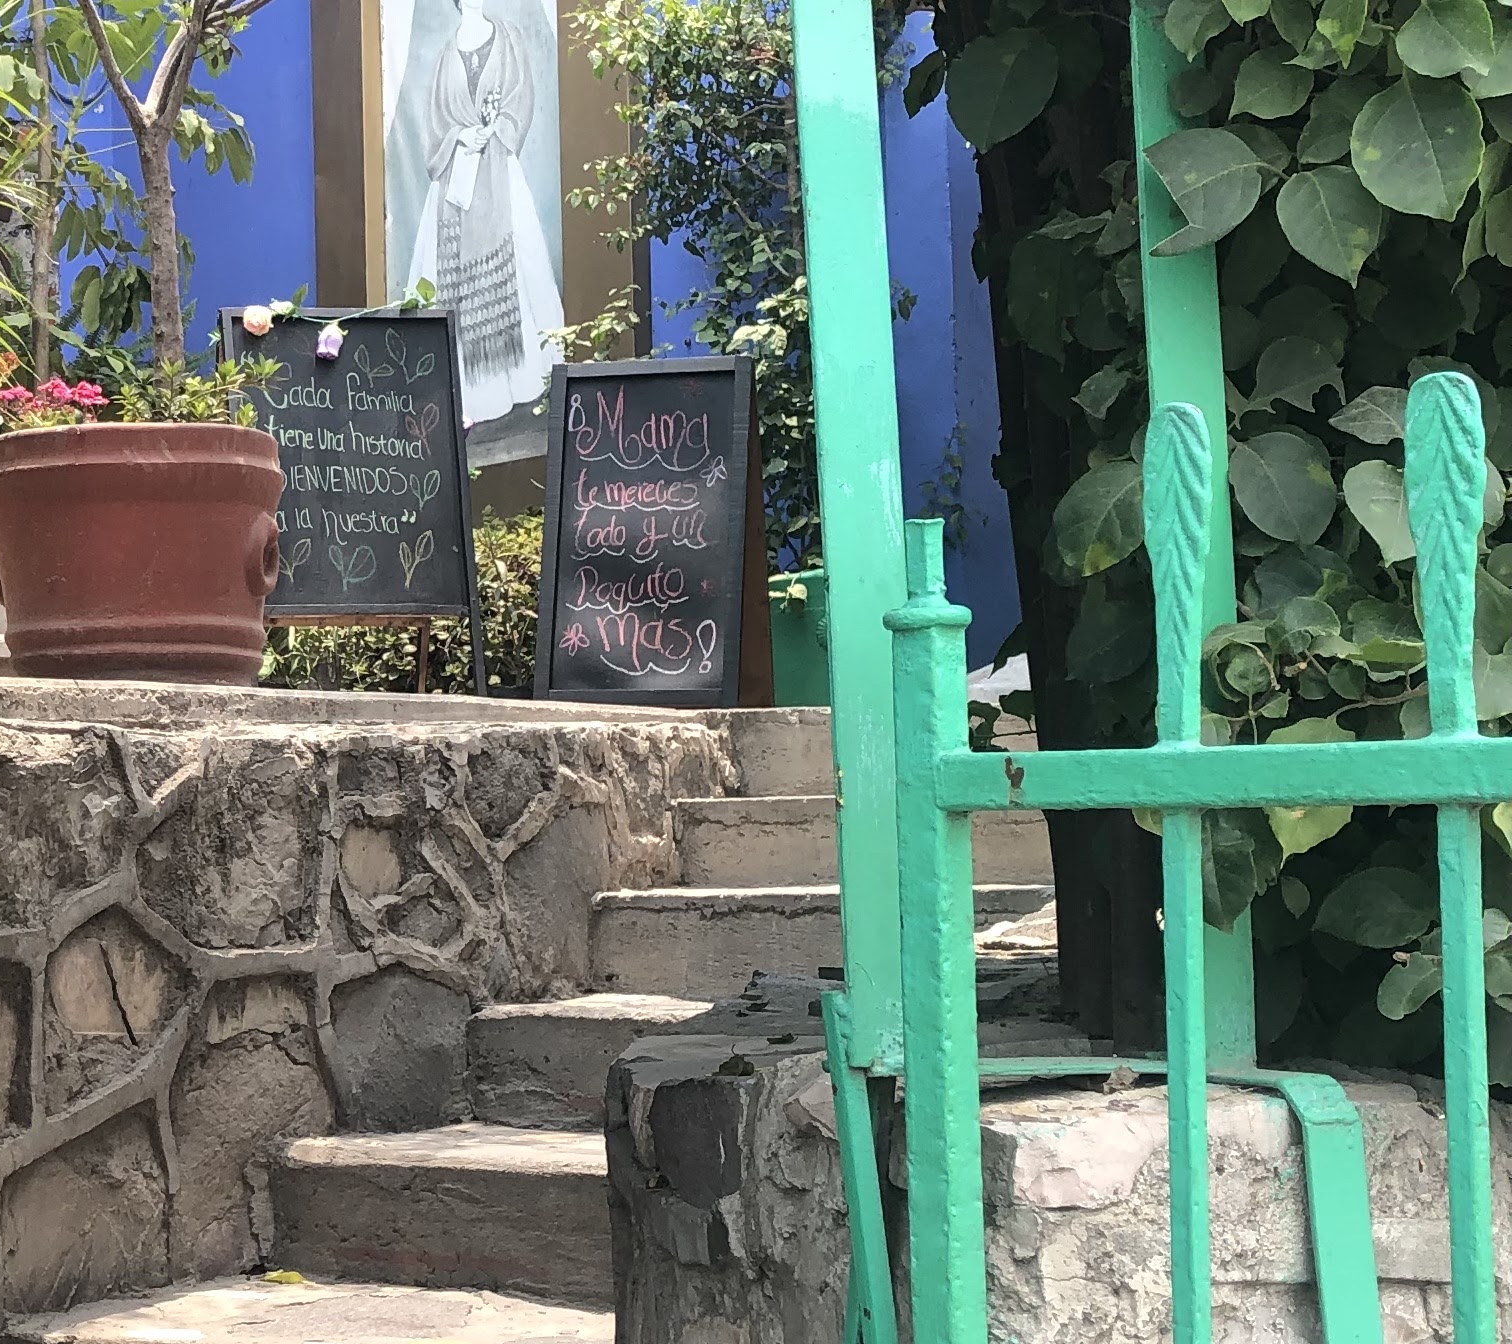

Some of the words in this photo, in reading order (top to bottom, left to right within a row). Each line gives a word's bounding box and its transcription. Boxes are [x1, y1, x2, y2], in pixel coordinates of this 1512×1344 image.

[346, 372, 417, 415] familia
[263, 414, 314, 450] tiene
[349, 420, 425, 460] historia
[573, 467, 599, 506] te
[295, 508, 314, 530] la
[635, 515, 668, 555] y
